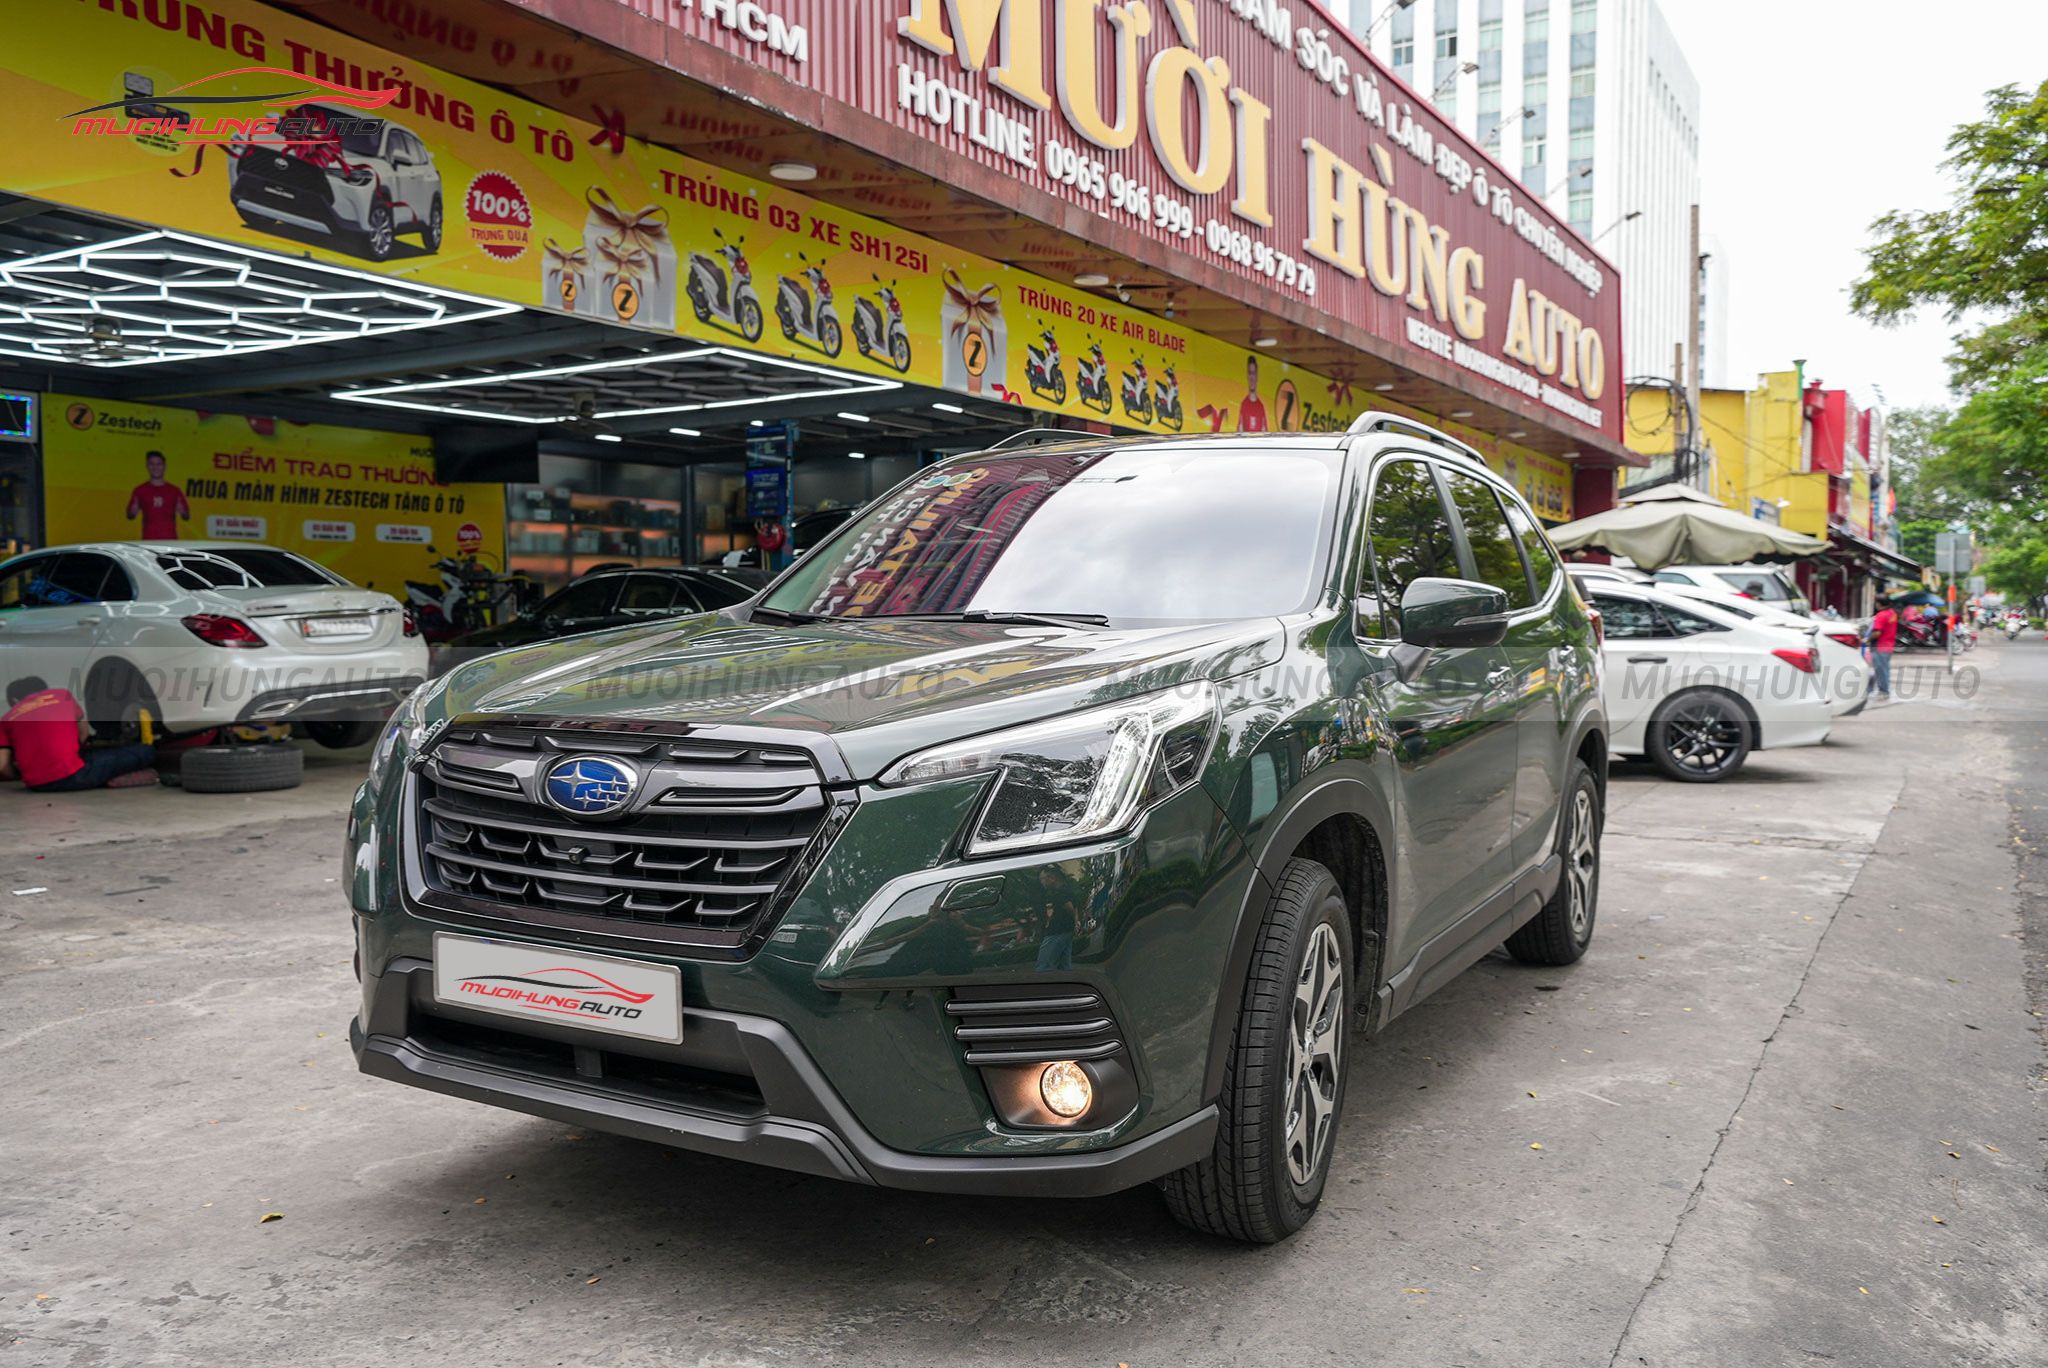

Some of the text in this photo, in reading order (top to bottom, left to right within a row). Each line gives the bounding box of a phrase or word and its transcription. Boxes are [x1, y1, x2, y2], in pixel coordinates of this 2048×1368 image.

[490, 108, 516, 145] Ô
[528, 125, 574, 163] TÔ
[1296, 27, 1350, 97] SÓC
[1353, 72, 1384, 128] VÀ
[1386, 102, 1434, 166] LÀM
[1434, 143, 1472, 194] ĐẸP
[1472, 167, 1489, 206] Ô
[1489, 184, 1514, 226] TÔ
[472, 189, 529, 224] 100%
[659, 169, 929, 274] TRÚNG 03 XE SH125I
[1045, 140, 1106, 200] 0965
[1108, 172, 1151, 222] 966
[1206, 218, 1253, 268] 0968
[1302, 137, 1487, 340] HÙNG
[1503, 278, 1606, 400] AUTO
[1017, 285, 1186, 354] TRÚNG 20 XE AIR BLADE
[97, 412, 162, 432] Zestech
[186, 478, 229, 500] MUA
[234, 480, 276, 504] MÀN
[281, 482, 321, 505] HÌNH
[325, 488, 390, 511] ZESTECH
[212, 447, 450, 488] ĐIỂM TRAO THƯỞN
